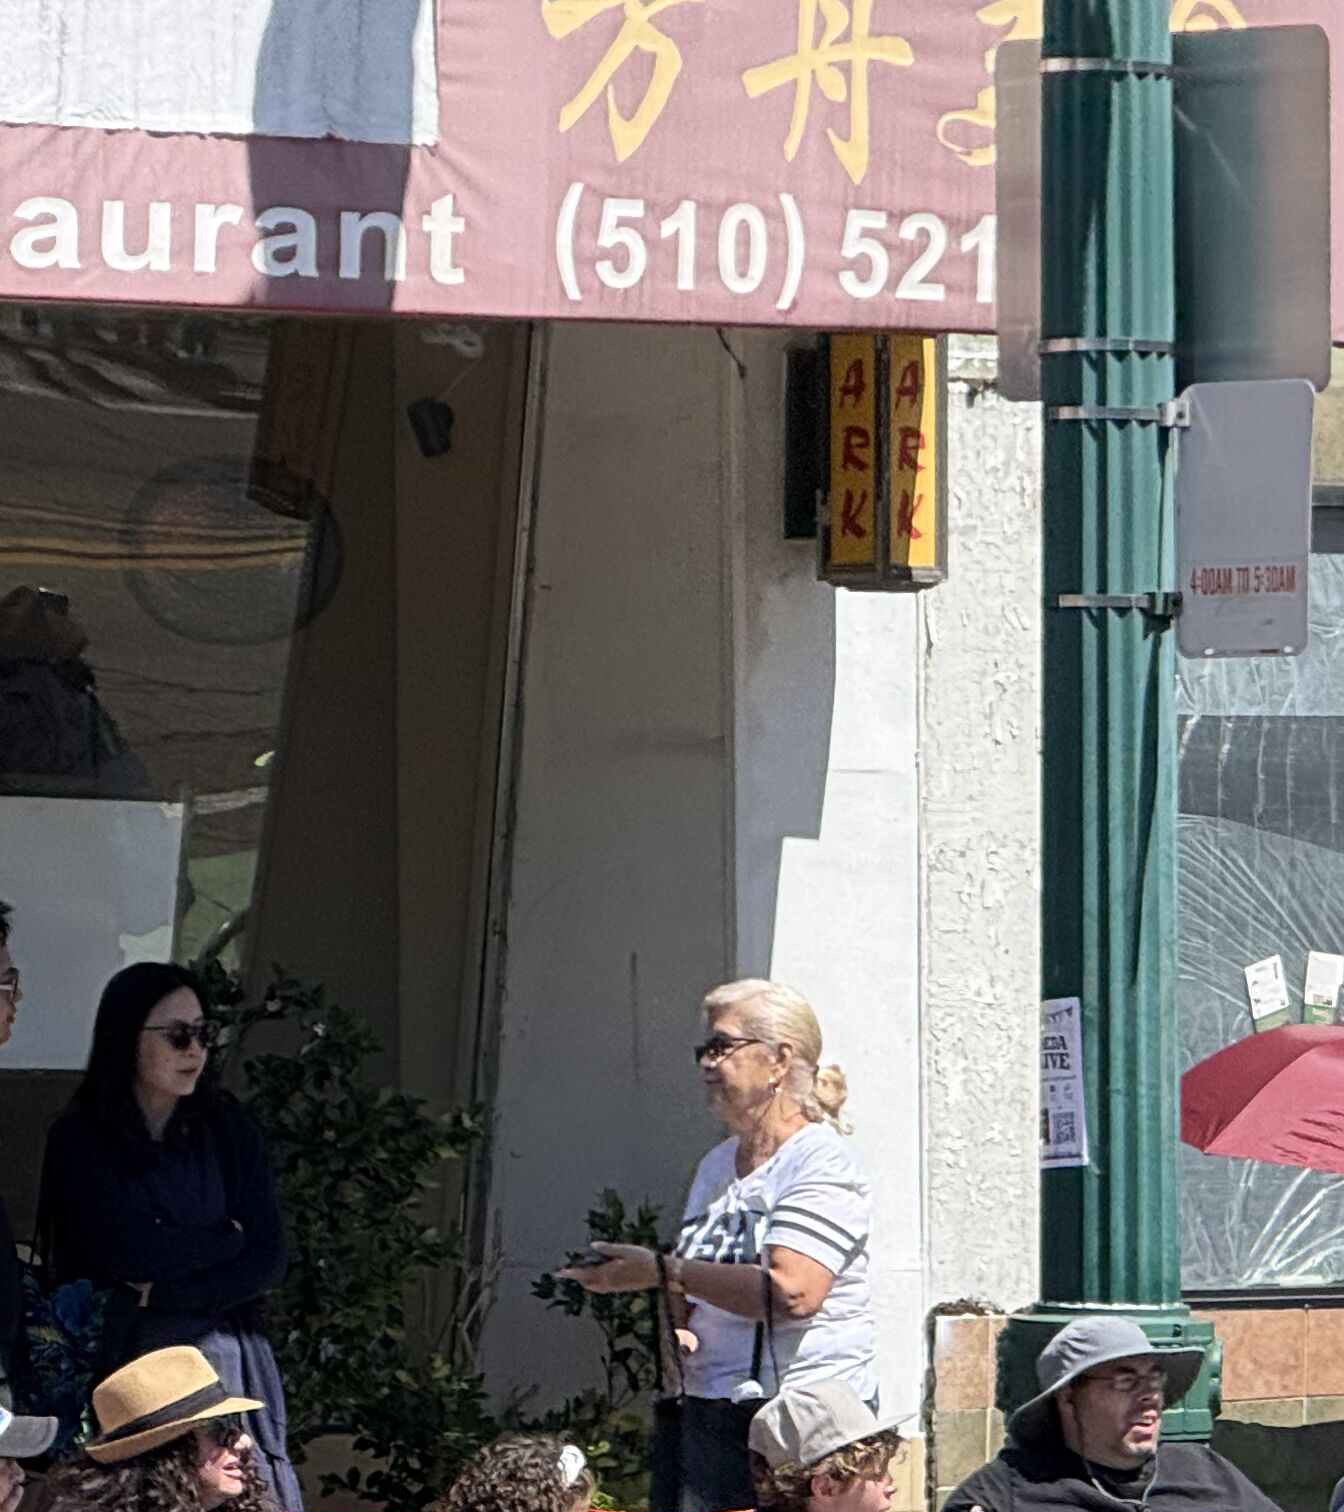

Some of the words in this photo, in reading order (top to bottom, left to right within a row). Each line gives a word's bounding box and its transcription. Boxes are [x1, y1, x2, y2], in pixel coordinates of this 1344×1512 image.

[9, 194, 467, 285] aurant
[555, 182, 804, 311] (510)
[838, 209, 996, 302] 521
[838, 358, 870, 540] ARK
[895, 360, 926, 541] ARK
[1236, 566, 1250, 594] TO
[1042, 1036, 1067, 1050] EDA
[1042, 1052, 1071, 1070] IVE
